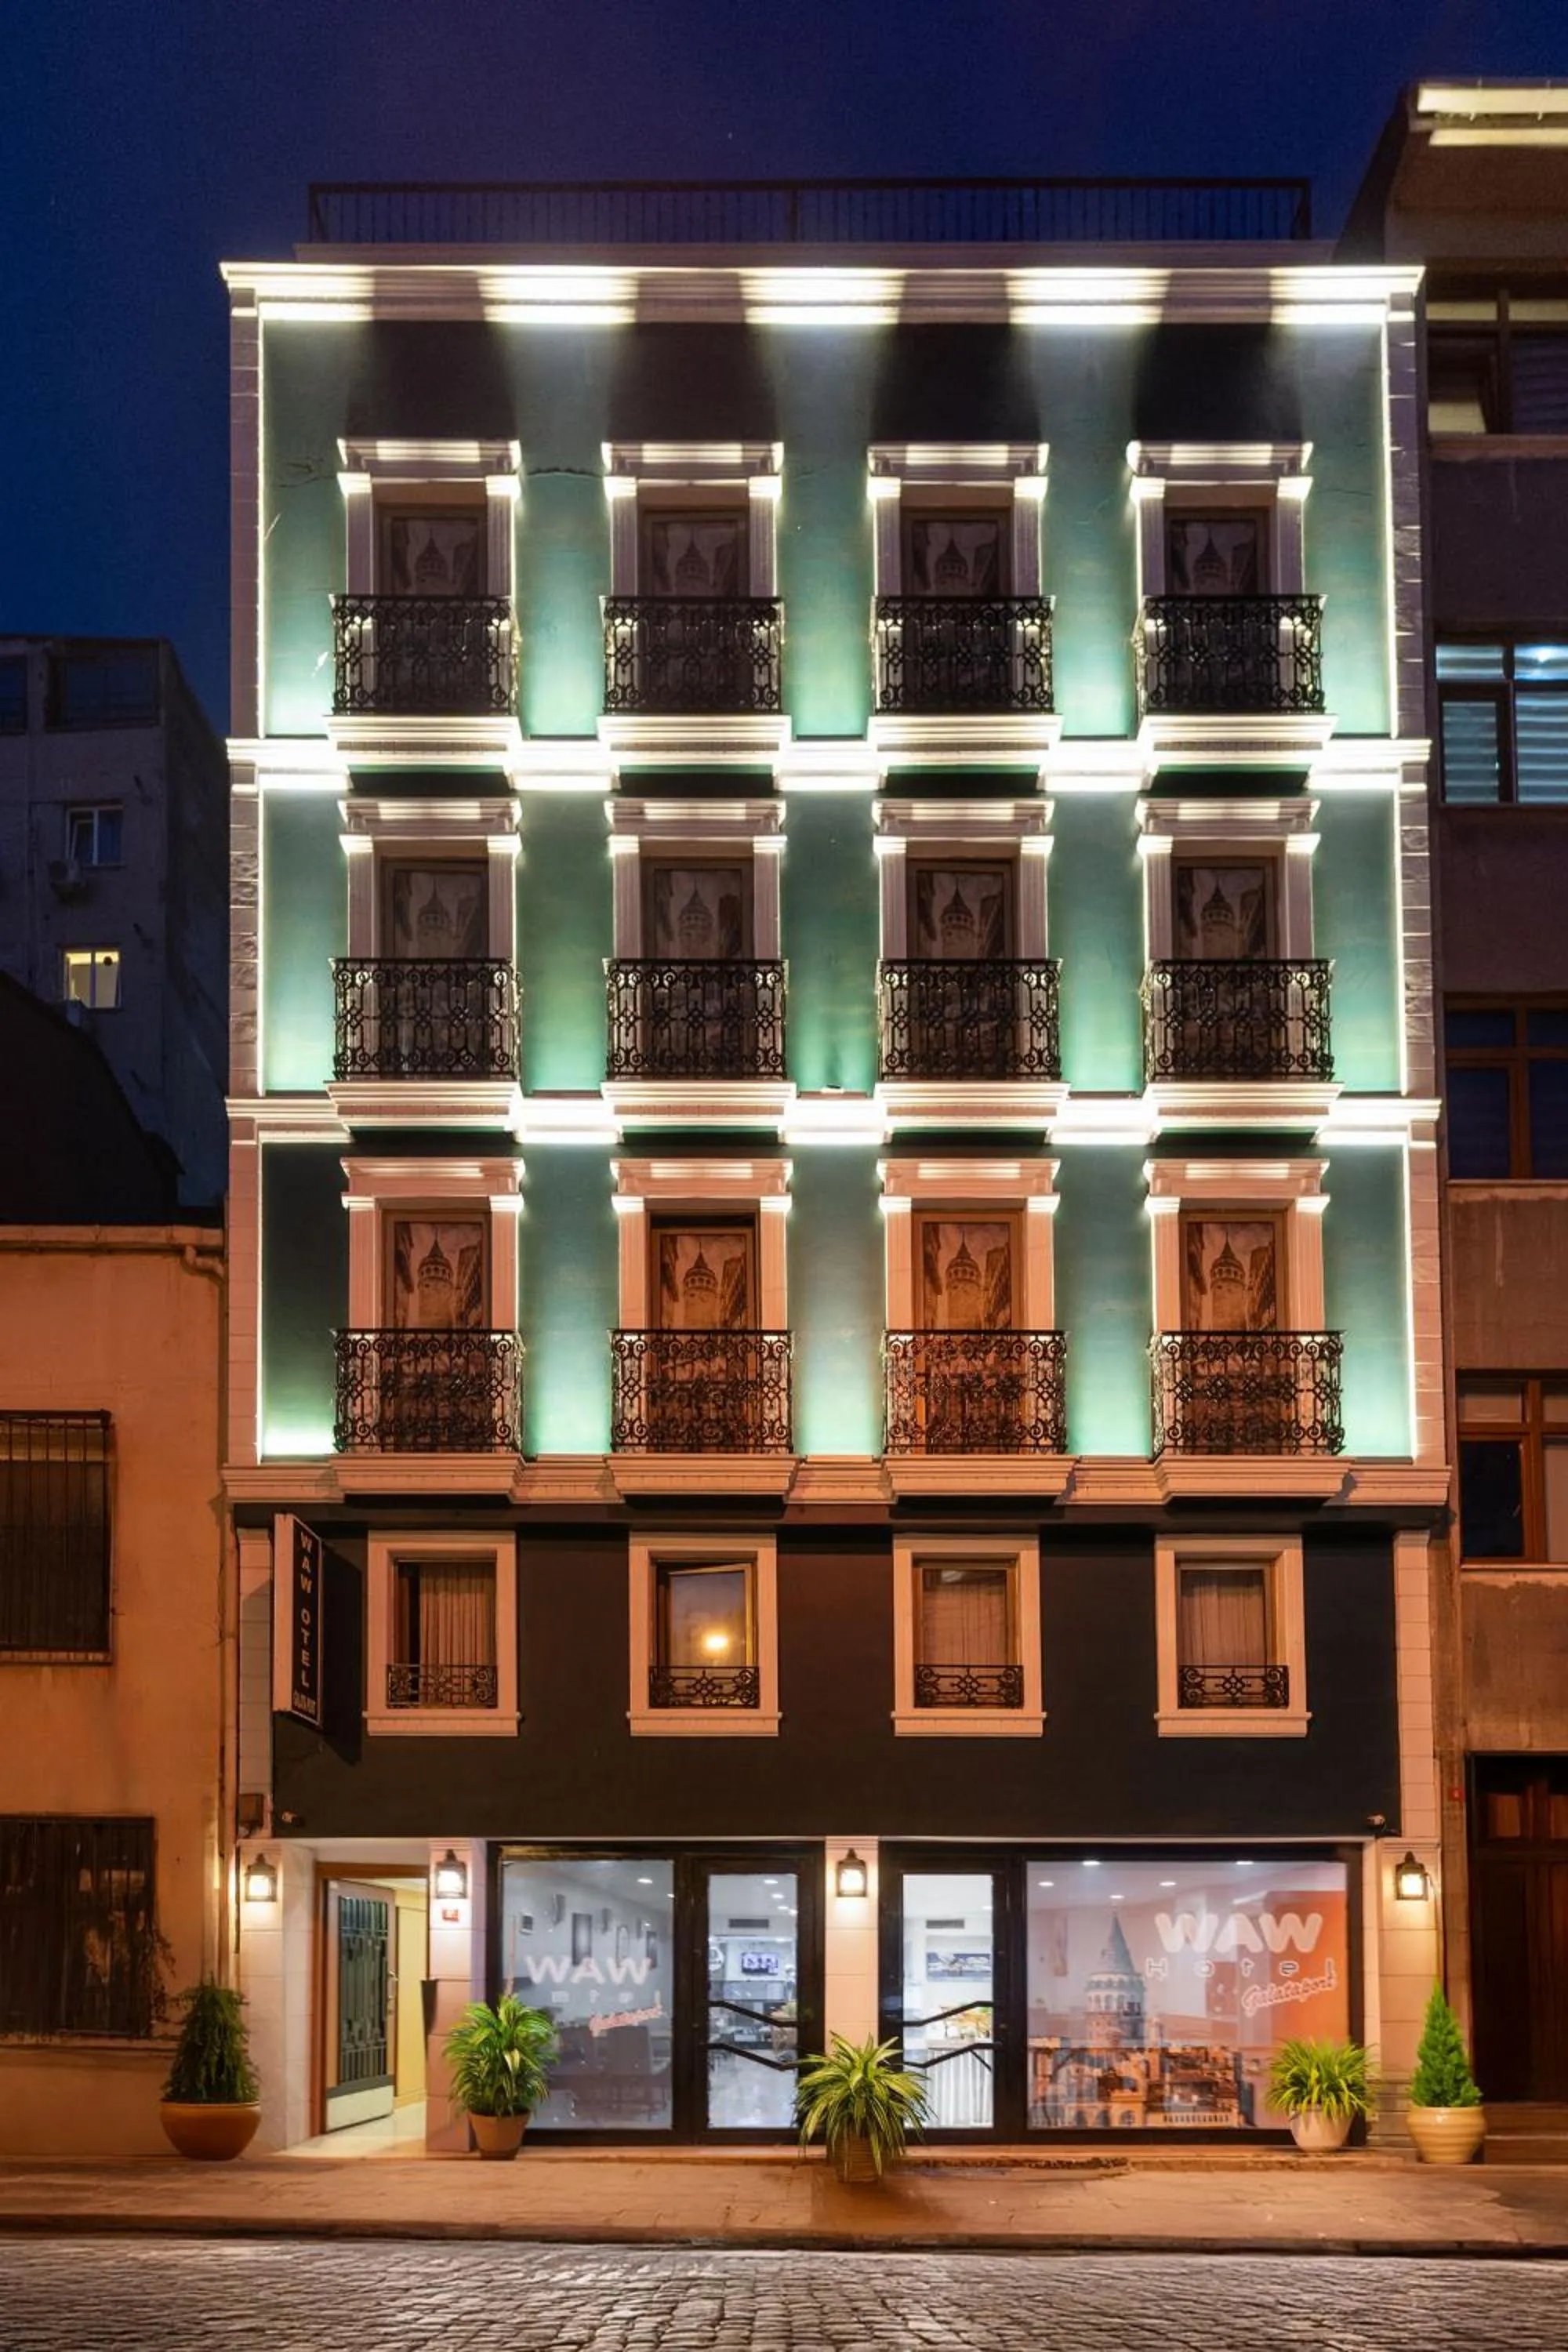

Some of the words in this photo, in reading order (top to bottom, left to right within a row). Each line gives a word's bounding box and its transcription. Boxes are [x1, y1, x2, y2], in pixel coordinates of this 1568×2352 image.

[300, 1531, 312, 1594] WAW
[300, 1608, 310, 1688] OTEL
[1154, 1912, 1323, 1954] WAW
[526, 1955, 652, 1984] WAW
